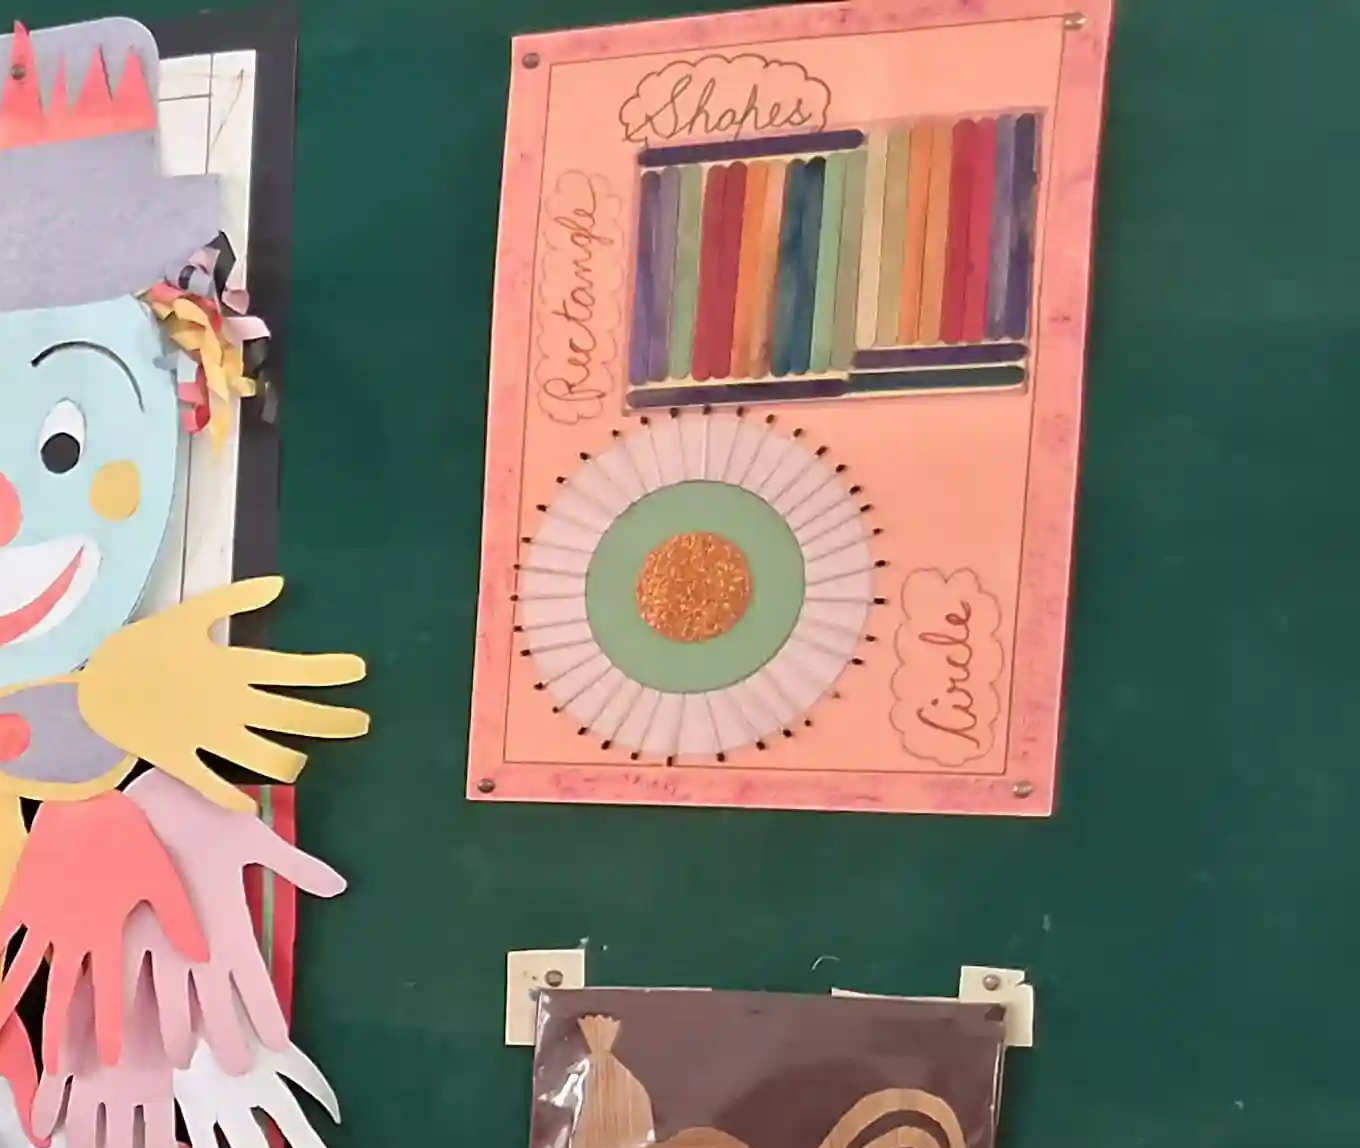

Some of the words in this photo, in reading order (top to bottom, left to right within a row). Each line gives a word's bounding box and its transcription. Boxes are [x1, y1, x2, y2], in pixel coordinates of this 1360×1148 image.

[627, 73, 813, 142] Shapes
[543, 180, 614, 401] Rectangle
[917, 598, 981, 748] Circle
